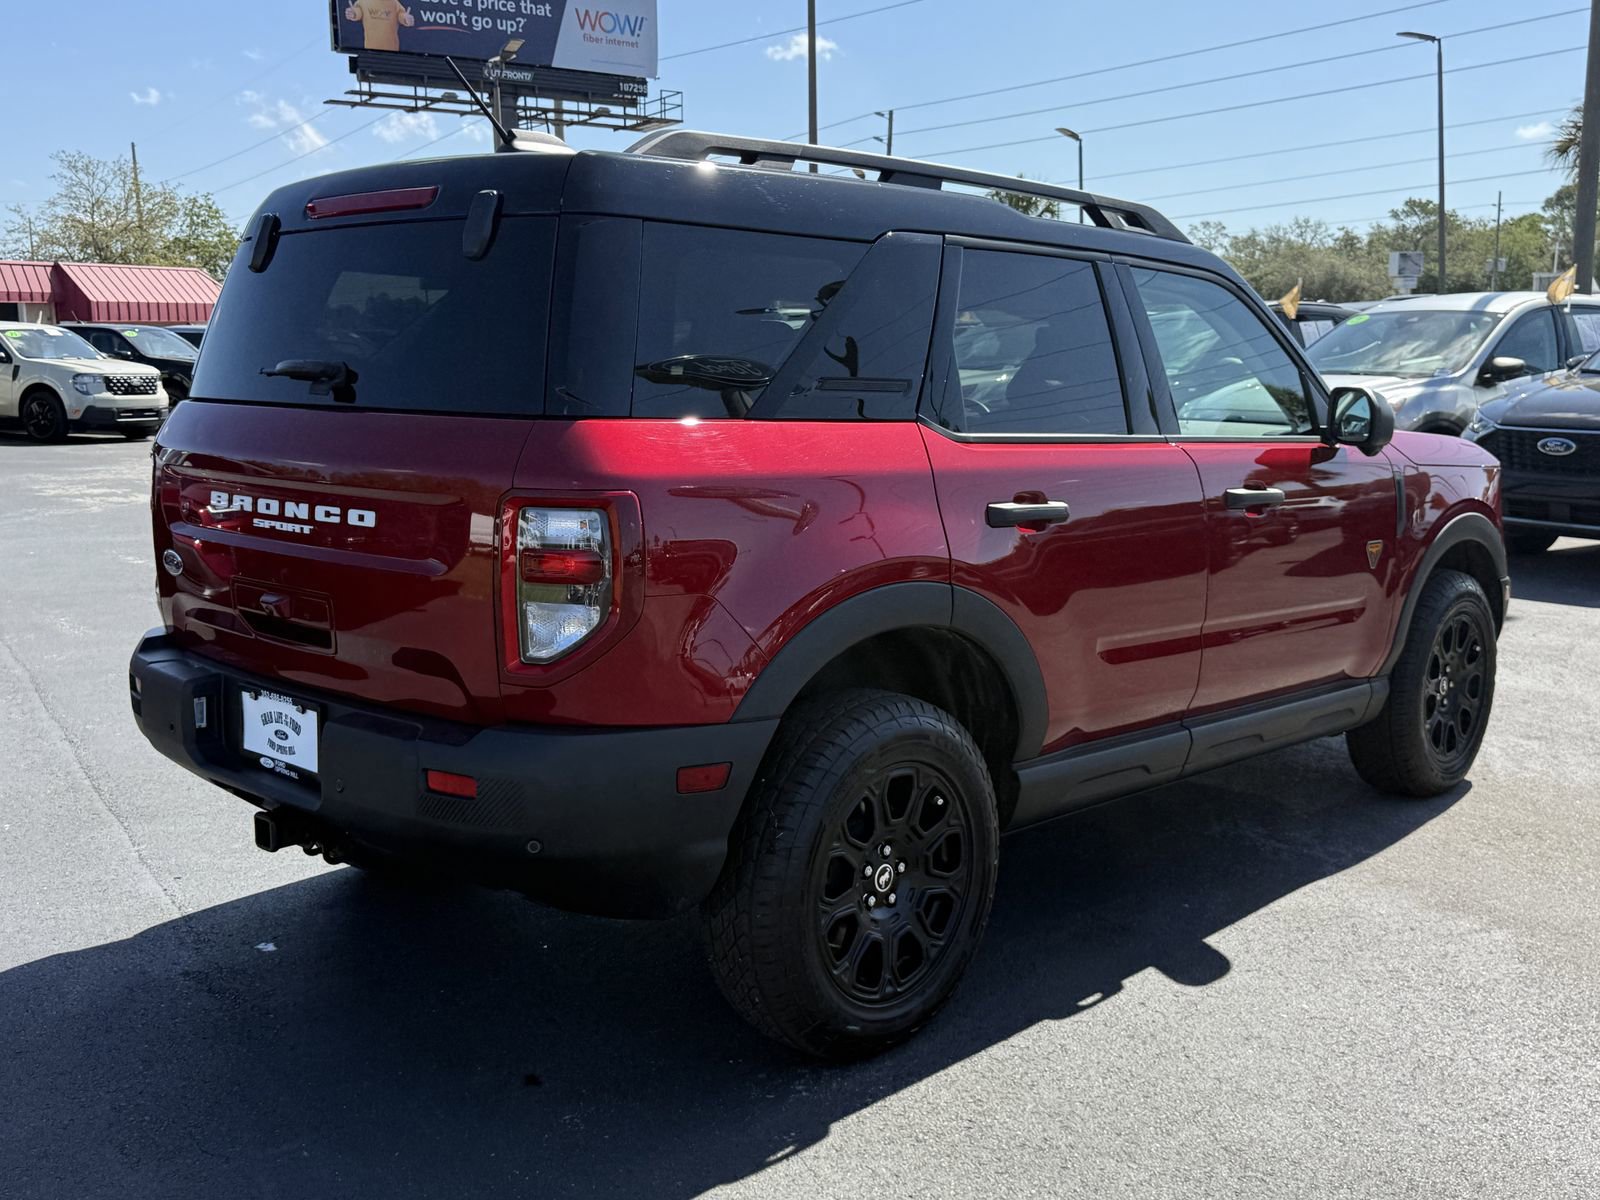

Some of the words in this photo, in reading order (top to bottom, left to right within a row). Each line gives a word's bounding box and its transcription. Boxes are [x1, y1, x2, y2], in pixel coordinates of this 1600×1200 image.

[477, 0, 516, 12] price
[520, 0, 552, 17] that
[420, 10, 468, 26] won't
[471, 16, 492, 31] go
[574, 7, 644, 38] WOW!
[583, 33, 603, 44] fiber
[605, 36, 639, 49] internet
[210, 490, 376, 528] BRONCO
[252, 518, 314, 534] SPORT
